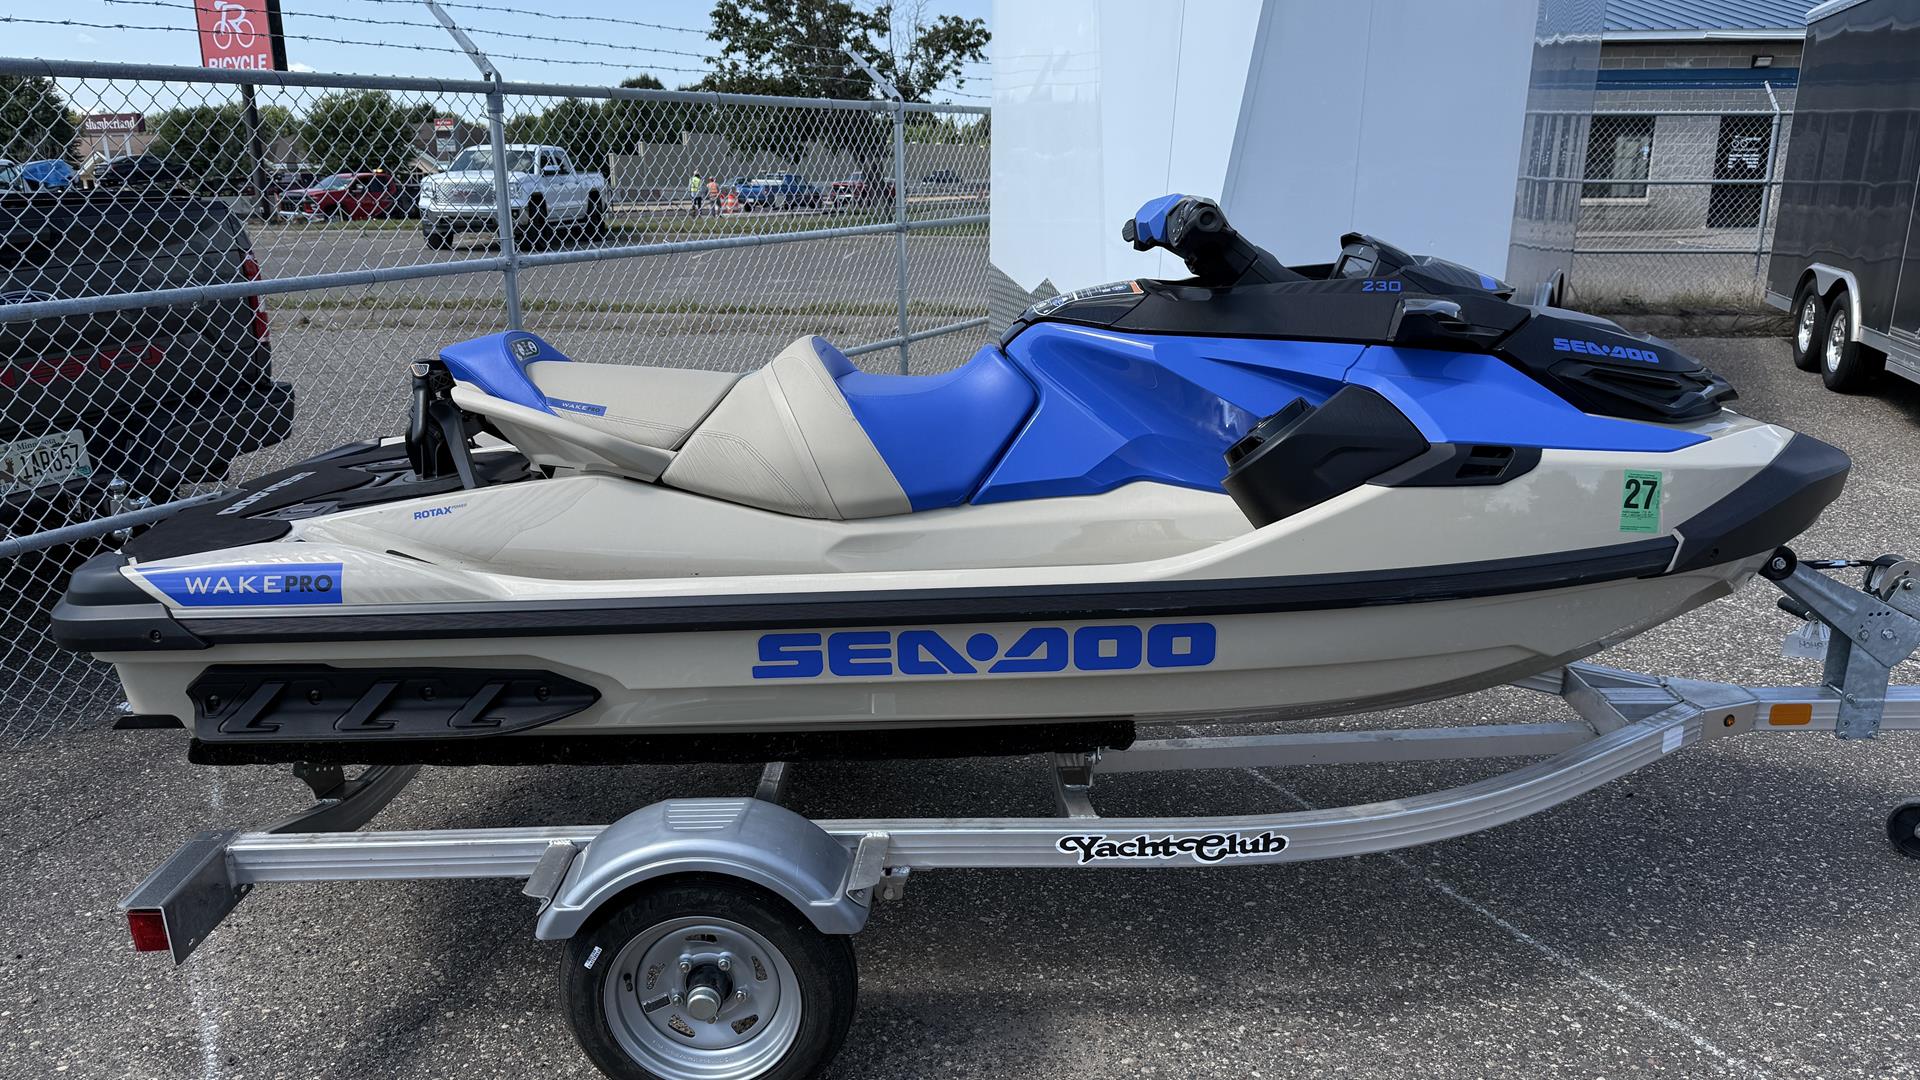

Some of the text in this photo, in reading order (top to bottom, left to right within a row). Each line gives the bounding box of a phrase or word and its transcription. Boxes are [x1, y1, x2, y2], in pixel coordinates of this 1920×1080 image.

[208, 53, 267, 70] BICYCLE
[1362, 280, 1401, 292] 230
[1624, 478, 1658, 510] 27
[413, 505, 452, 520] ROTAX
[1059, 832, 1287, 863] Yacht Club
